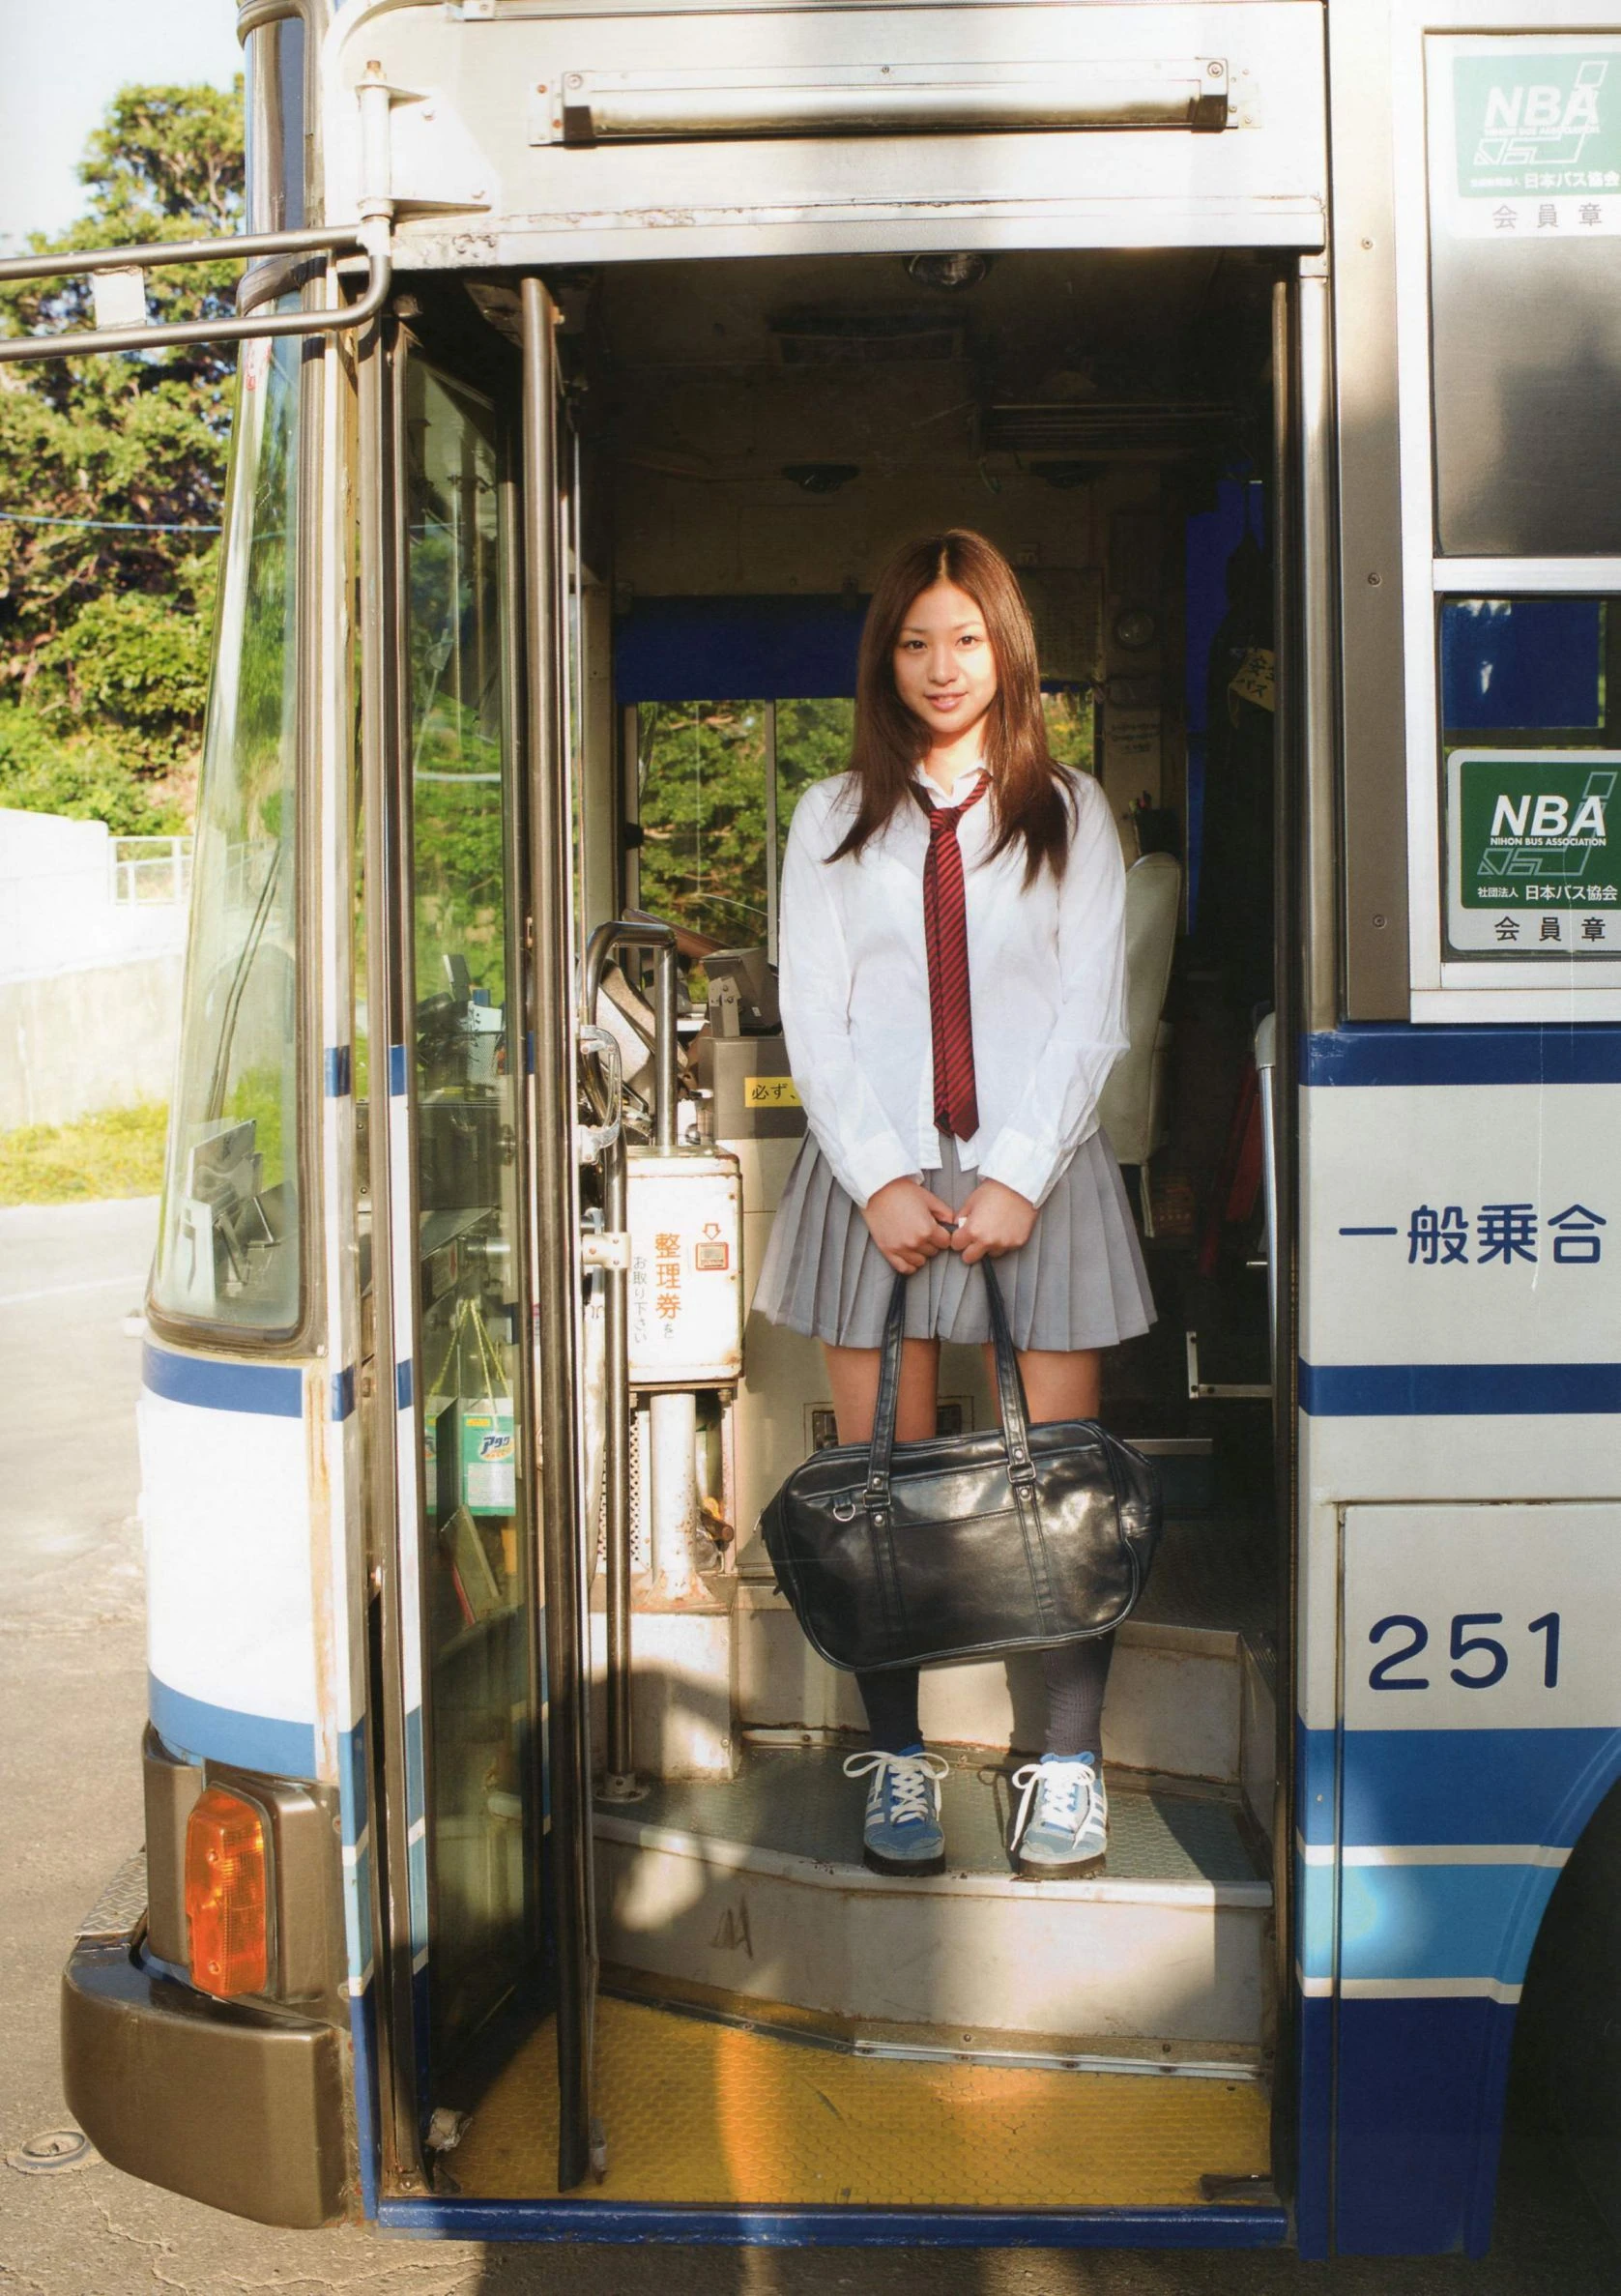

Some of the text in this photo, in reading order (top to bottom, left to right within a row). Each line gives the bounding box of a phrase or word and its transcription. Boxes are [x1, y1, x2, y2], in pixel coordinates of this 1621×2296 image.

[1484, 84, 1600, 127] NBA
[1492, 202, 1603, 230] 会員章
[1491, 795, 1607, 836] NBA
[1490, 837, 1607, 847] NIHON BUS ASSOCIATION
[1477, 885, 1618, 901] 社団法人 日本バス協会
[1494, 915, 1607, 943] 会員章
[1338, 1204, 1607, 1265] 一般乗合
[632, 1256, 648, 1344] お取り下さい
[1368, 1612, 1561, 1690] 251
